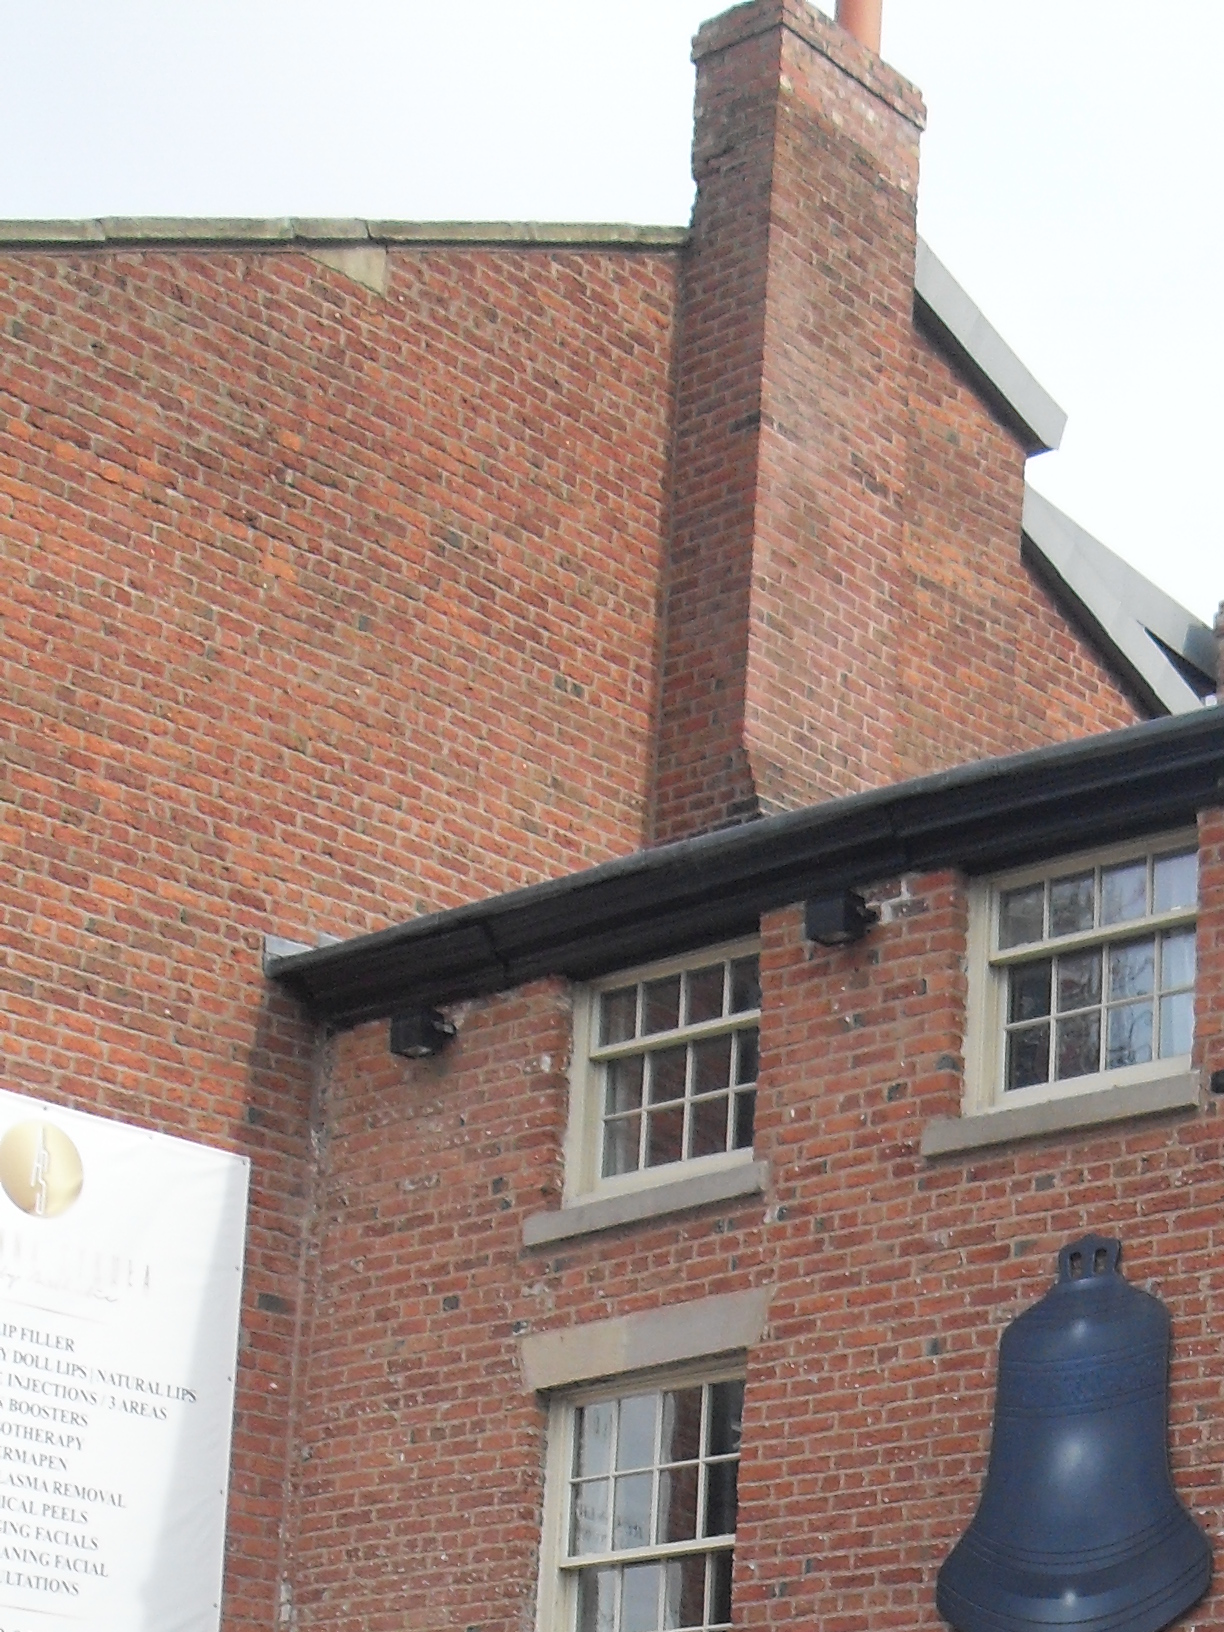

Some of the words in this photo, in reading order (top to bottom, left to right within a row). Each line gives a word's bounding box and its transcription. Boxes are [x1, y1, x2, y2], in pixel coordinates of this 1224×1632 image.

[0, 1323, 17, 1338] IP
[20, 1327, 75, 1352] FILLER
[13, 1350, 52, 1372] DOLL
[56, 1359, 87, 1379] LIPS
[97, 1369, 163, 1396] NATURAL
[166, 1385, 197, 1403] LIPS
[8, 1373, 97, 1406] INJECTIONS
[108, 1396, 116, 1410] 3
[120, 1399, 167, 1420] AREAS
[9, 1398, 88, 1427] BOOSTERS
[0, 1421, 84, 1451] OTHERAPY
[0, 1473, 48, 1493] ASMA
[53, 1481, 126, 1508] REMOVAL
[42, 1503, 88, 1523] PEELS
[0, 1519, 30, 1538] ING
[35, 1526, 98, 1550] FACIALS
[54, 1555, 109, 1578] FACIAL
[0, 1570, 79, 1596] LTATIONS
